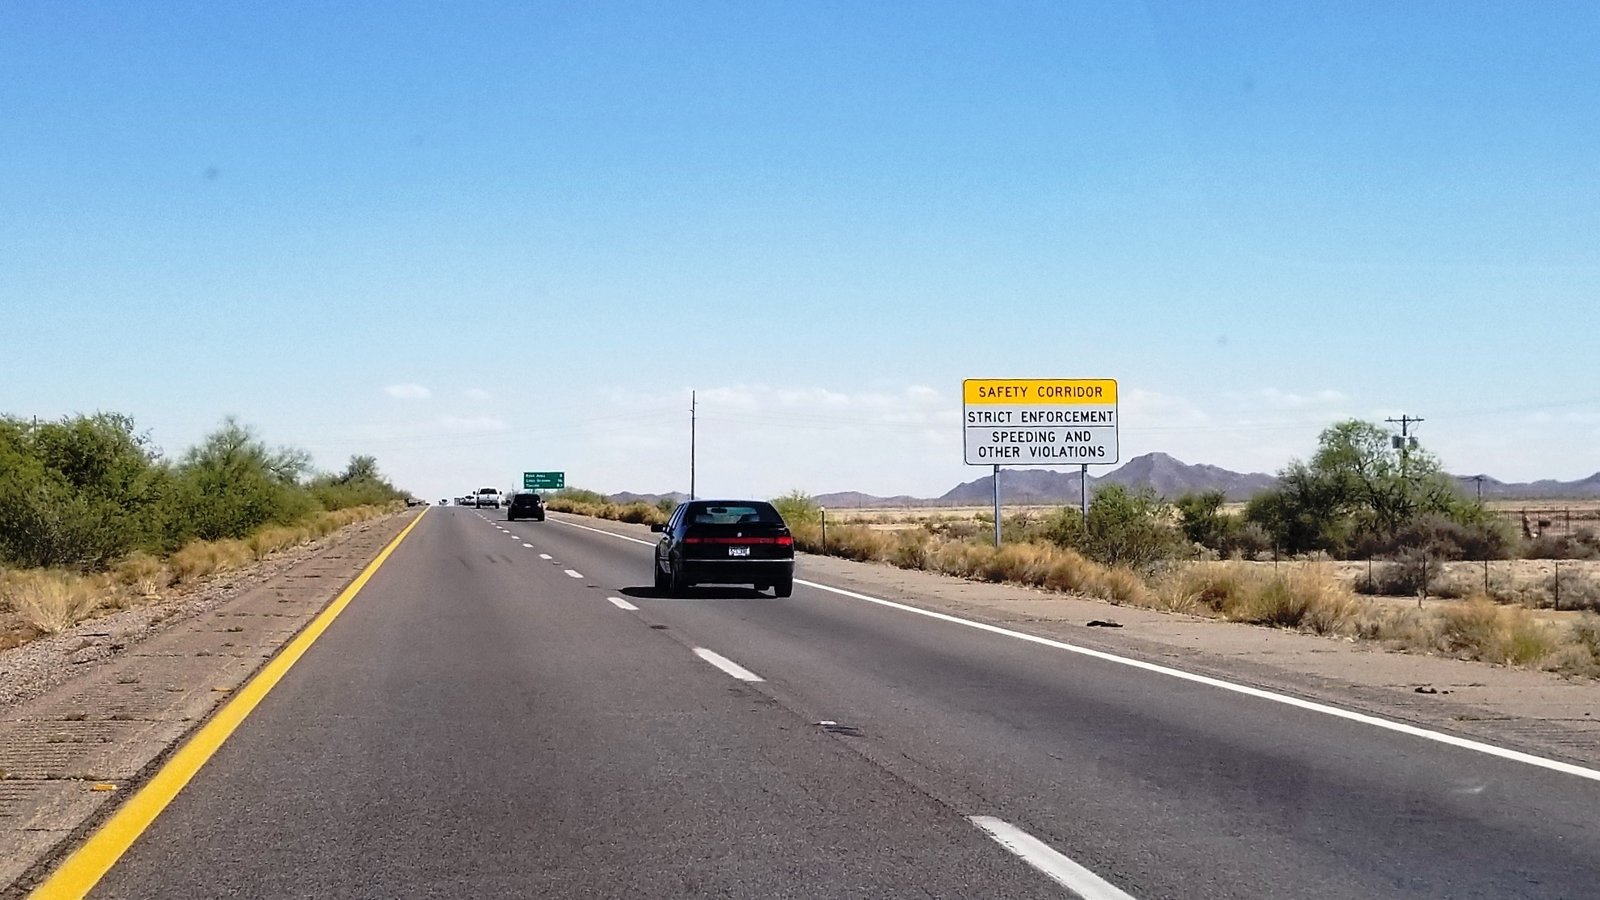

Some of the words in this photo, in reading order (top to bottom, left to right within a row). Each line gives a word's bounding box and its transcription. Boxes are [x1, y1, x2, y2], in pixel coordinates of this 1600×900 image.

[979, 386, 1028, 398] SAFETY
[1037, 386, 1103, 398] CORRIDOR
[967, 411, 1013, 423] STRICT
[1021, 411, 1114, 422] ENFORCEMENT
[992, 431, 1056, 443] SPEEDING
[1065, 431, 1091, 442] AND
[978, 446, 1020, 458] OTHER
[1029, 446, 1105, 457] VIOLATIONS
